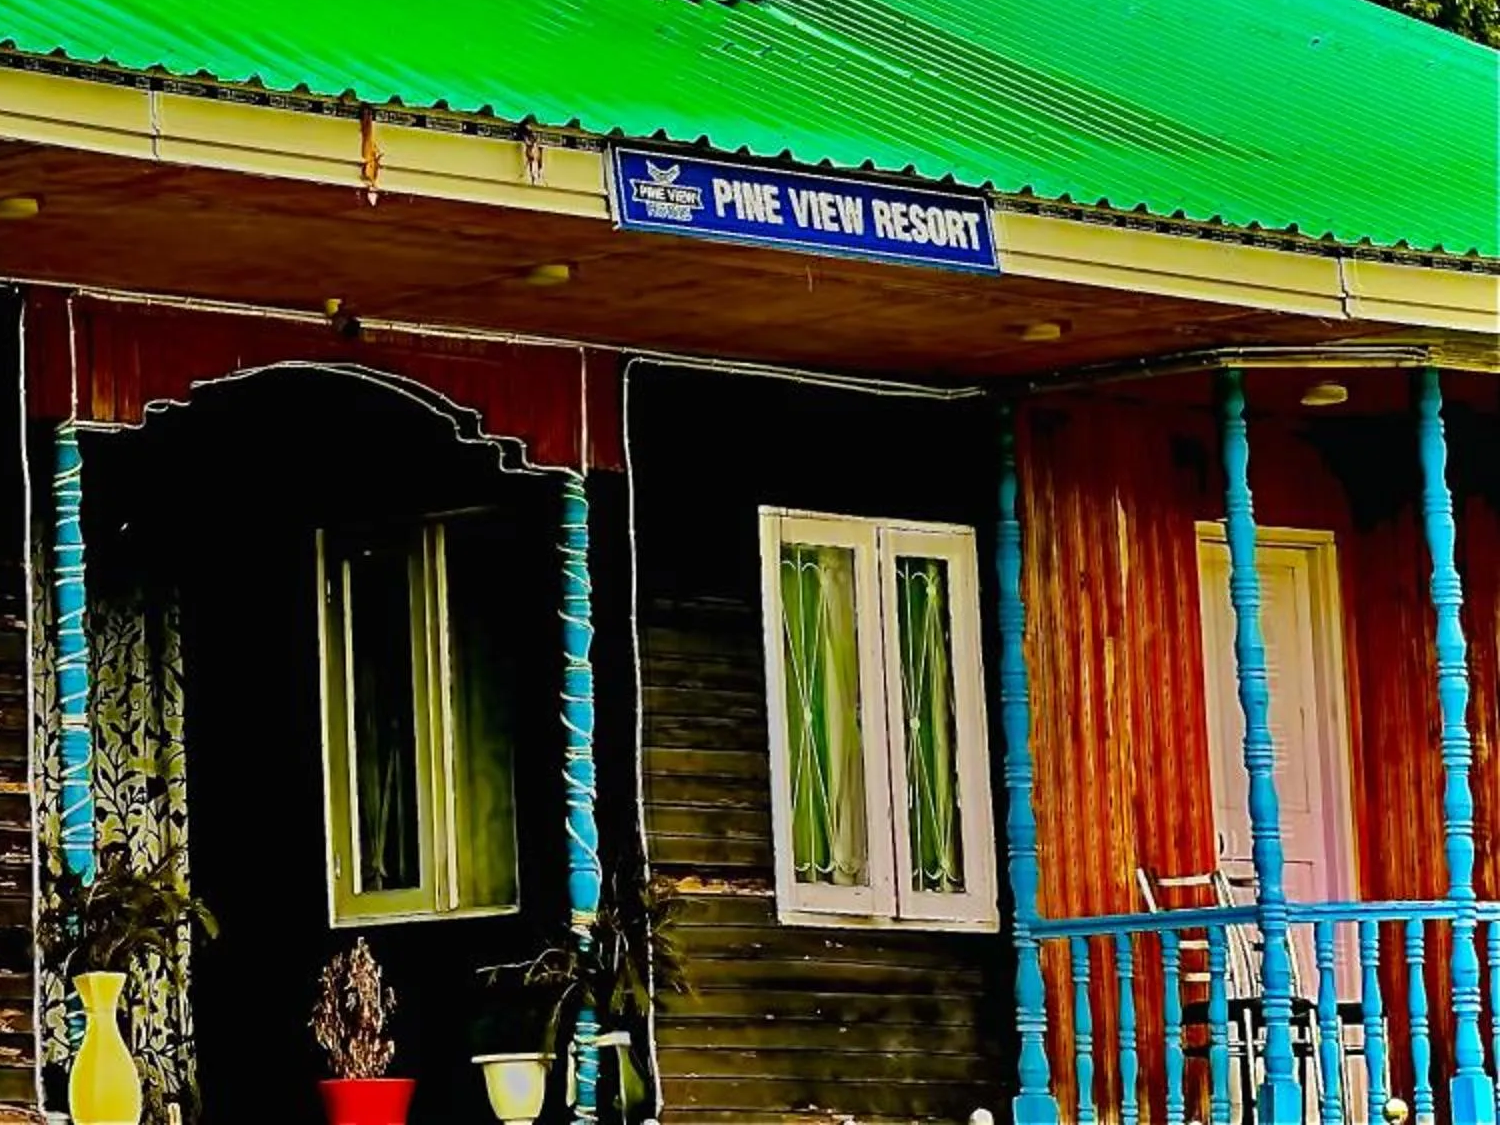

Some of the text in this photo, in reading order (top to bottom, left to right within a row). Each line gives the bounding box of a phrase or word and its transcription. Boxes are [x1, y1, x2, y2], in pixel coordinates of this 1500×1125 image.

[712, 178, 784, 225] PINE
[787, 187, 864, 236] VIEW
[871, 199, 982, 252] RESORT
